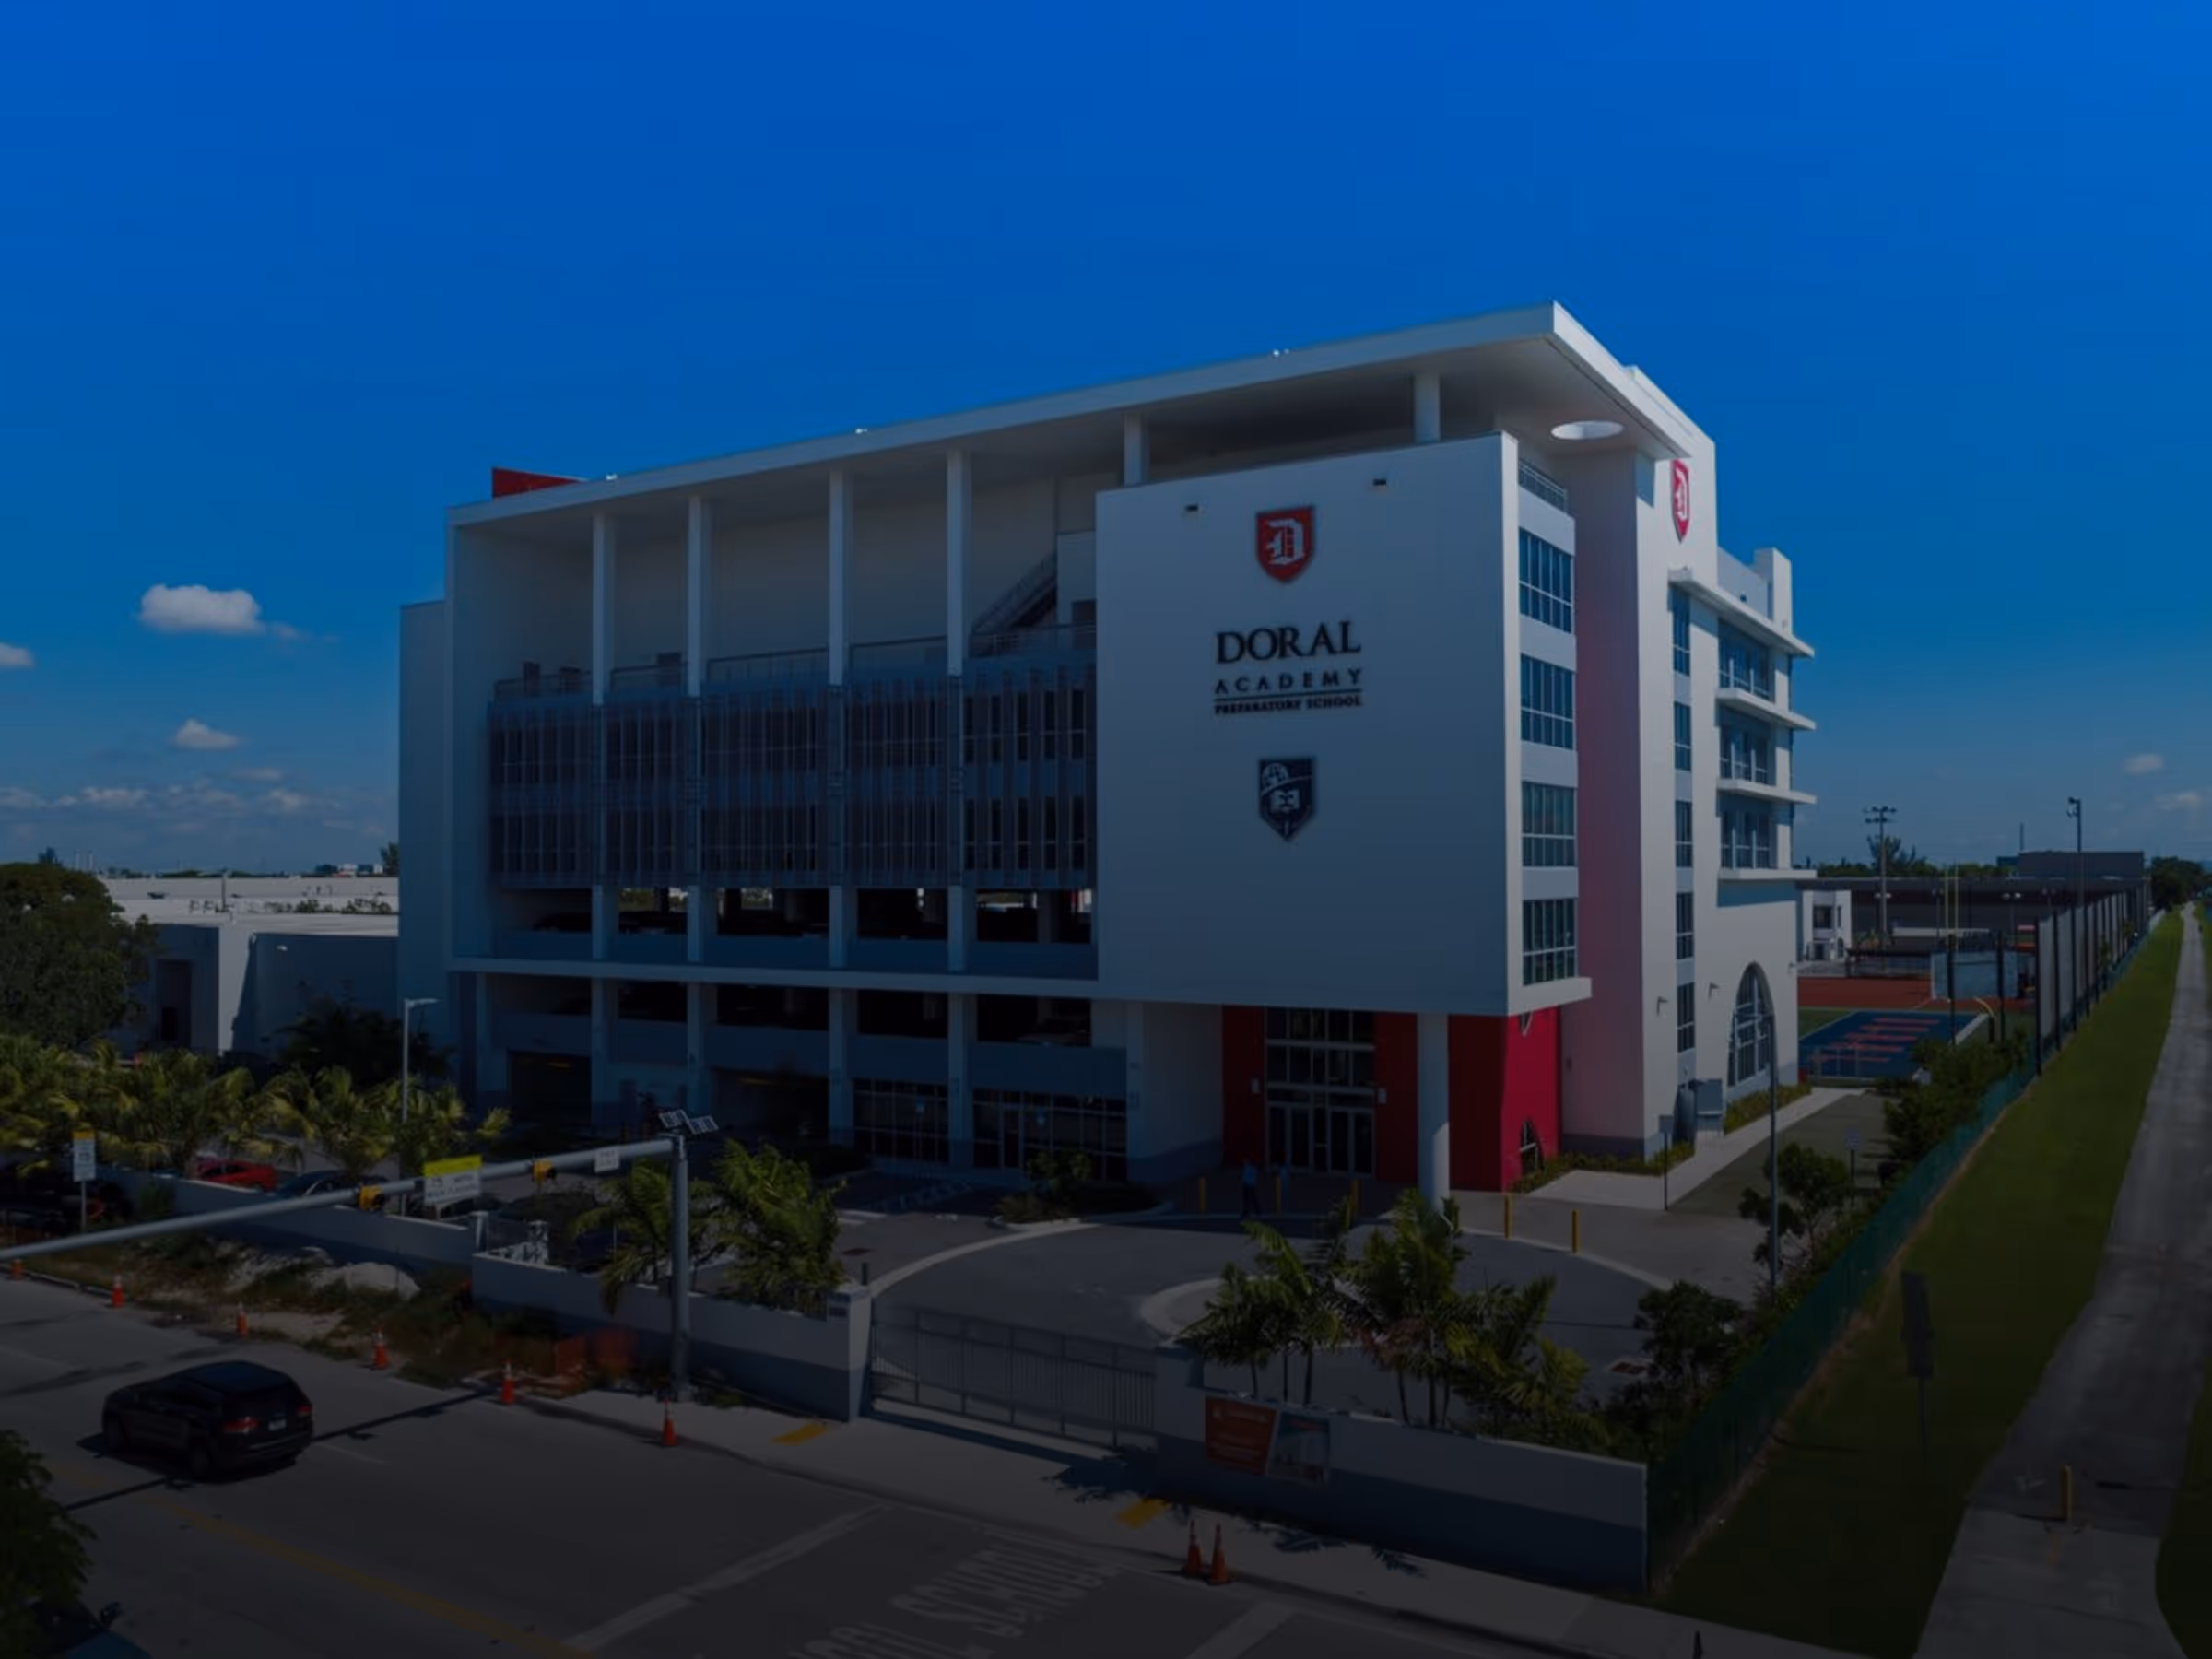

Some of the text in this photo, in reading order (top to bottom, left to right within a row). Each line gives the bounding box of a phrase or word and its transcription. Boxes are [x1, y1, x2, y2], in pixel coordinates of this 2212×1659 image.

[1265, 517, 1305, 566] D
[1216, 620, 1362, 665] DORAL
[1214, 667, 1362, 695] ACADEMY
[1214, 695, 1362, 715] PREPARATORY SCHOOL
